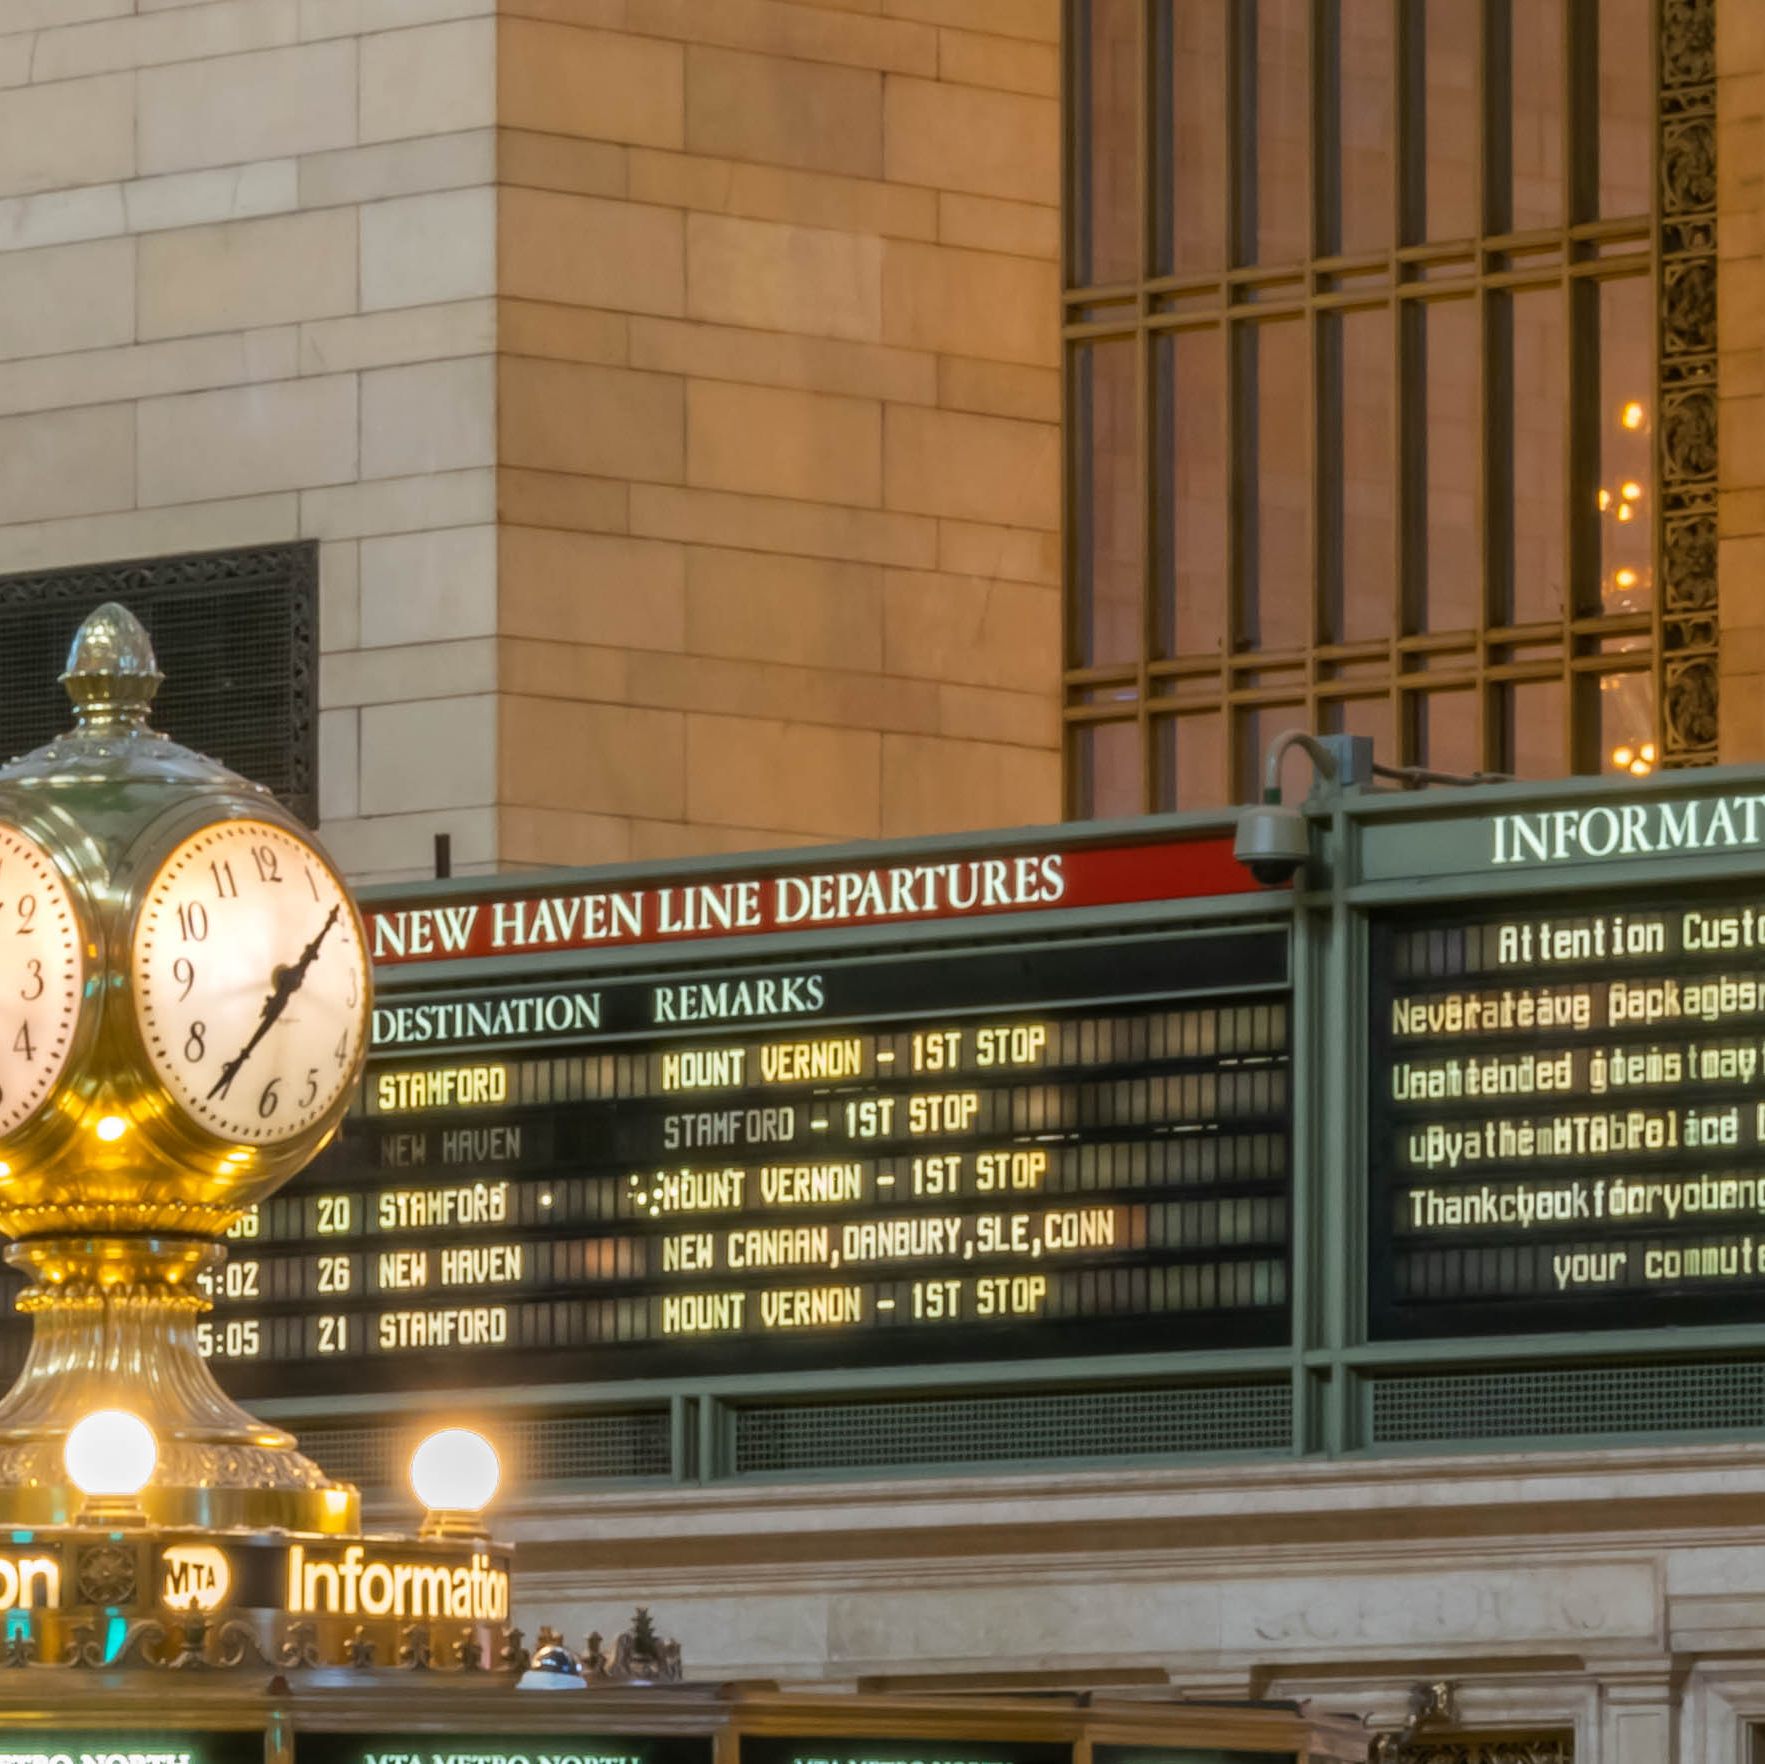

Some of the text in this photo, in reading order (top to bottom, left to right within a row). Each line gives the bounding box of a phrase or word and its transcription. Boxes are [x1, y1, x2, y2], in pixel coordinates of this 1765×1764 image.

[374, 855, 1064, 956] NEW HAVEN LINE DEPARTURES
[1499, 917, 1664, 963] Attention
[21, 959, 44, 1001] 3
[372, 976, 823, 1043] DESTINATION REMARKS
[379, 1026, 1045, 1109] STAMFORD MOUNT VERNON 1ST STOP
[443, 1094, 977, 1163] HAVEN STAMFORD 1ST STOP
[318, 1152, 1045, 1233] 20 STAMFORD VERNON 1ST STOP
[318, 1257, 350, 1292] 26
[380, 1253, 426, 1288] NEW
[442, 1246, 521, 1284] HAVEN
[664, 1234, 713, 1271] NEW
[1554, 1252, 1626, 1289] your
[197, 1276, 1045, 1357] 5:05 21 STAMFORD MOUNT VERNON 1ST STOP
[289, 1545, 507, 1620] Information
